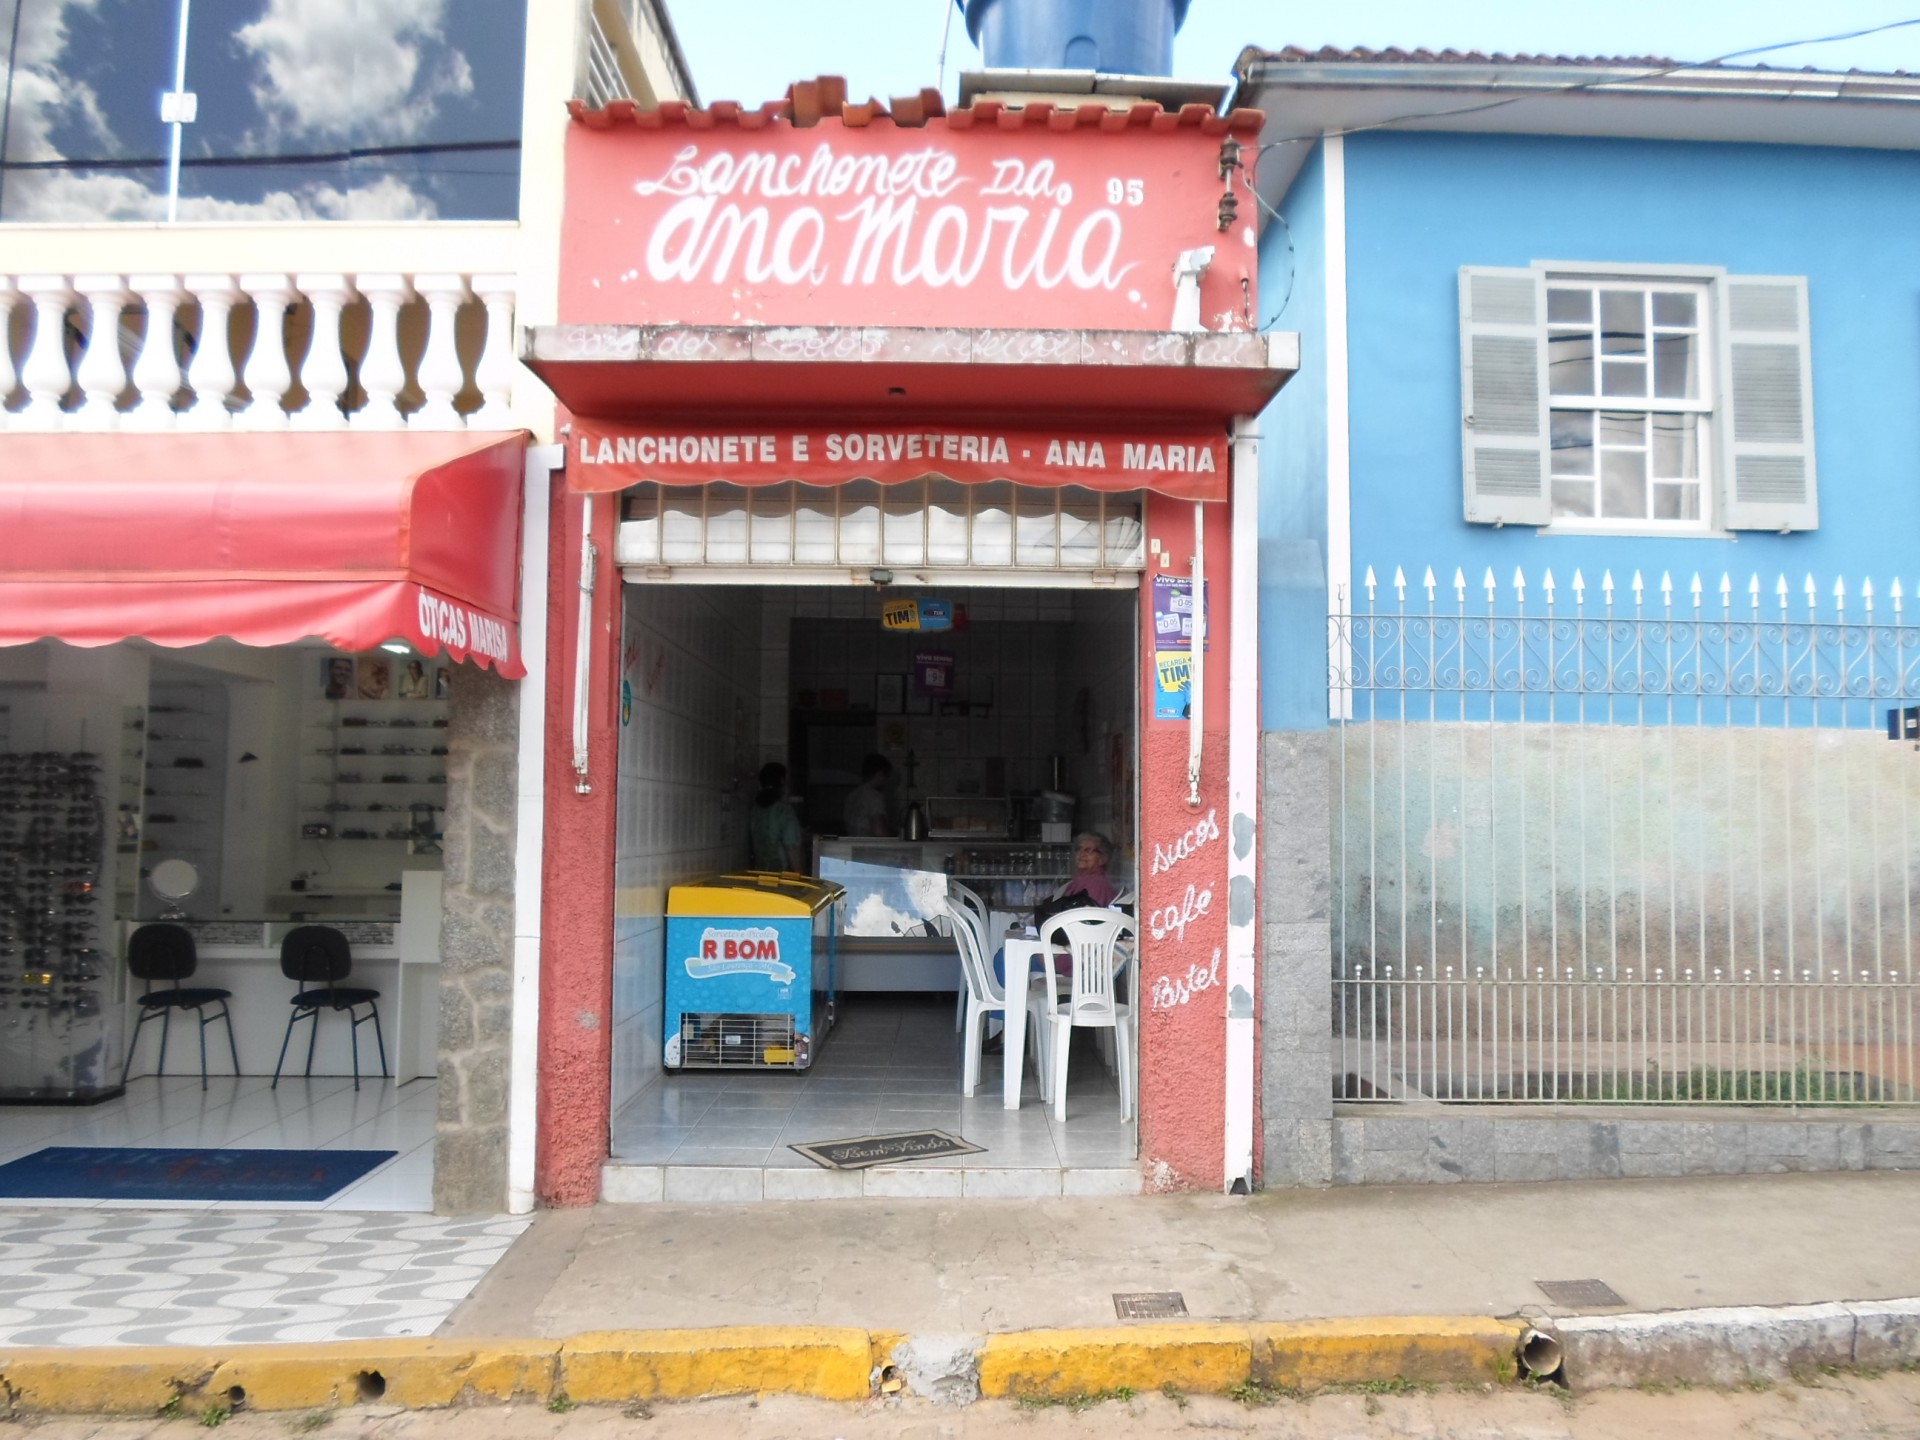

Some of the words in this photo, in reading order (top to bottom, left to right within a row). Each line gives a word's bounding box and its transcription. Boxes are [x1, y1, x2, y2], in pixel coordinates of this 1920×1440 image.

[633, 142, 974, 198] Lanchonete
[1107, 178, 1144, 204] 95
[579, 435, 777, 465] LANCHONETE
[792, 435, 810, 461] E
[825, 433, 1010, 463] SORVETERIA
[1044, 439, 1106, 468] ANA
[1122, 442, 1216, 473] MARIA
[885, 609, 910, 626] TIM
[468, 611, 508, 663] MARISA
[1159, 658, 1187, 667] RECARGA
[1160, 664, 1190, 683] TIM
[1150, 880, 1216, 943] café
[703, 940, 718, 960] R
[724, 940, 777, 960] BOM
